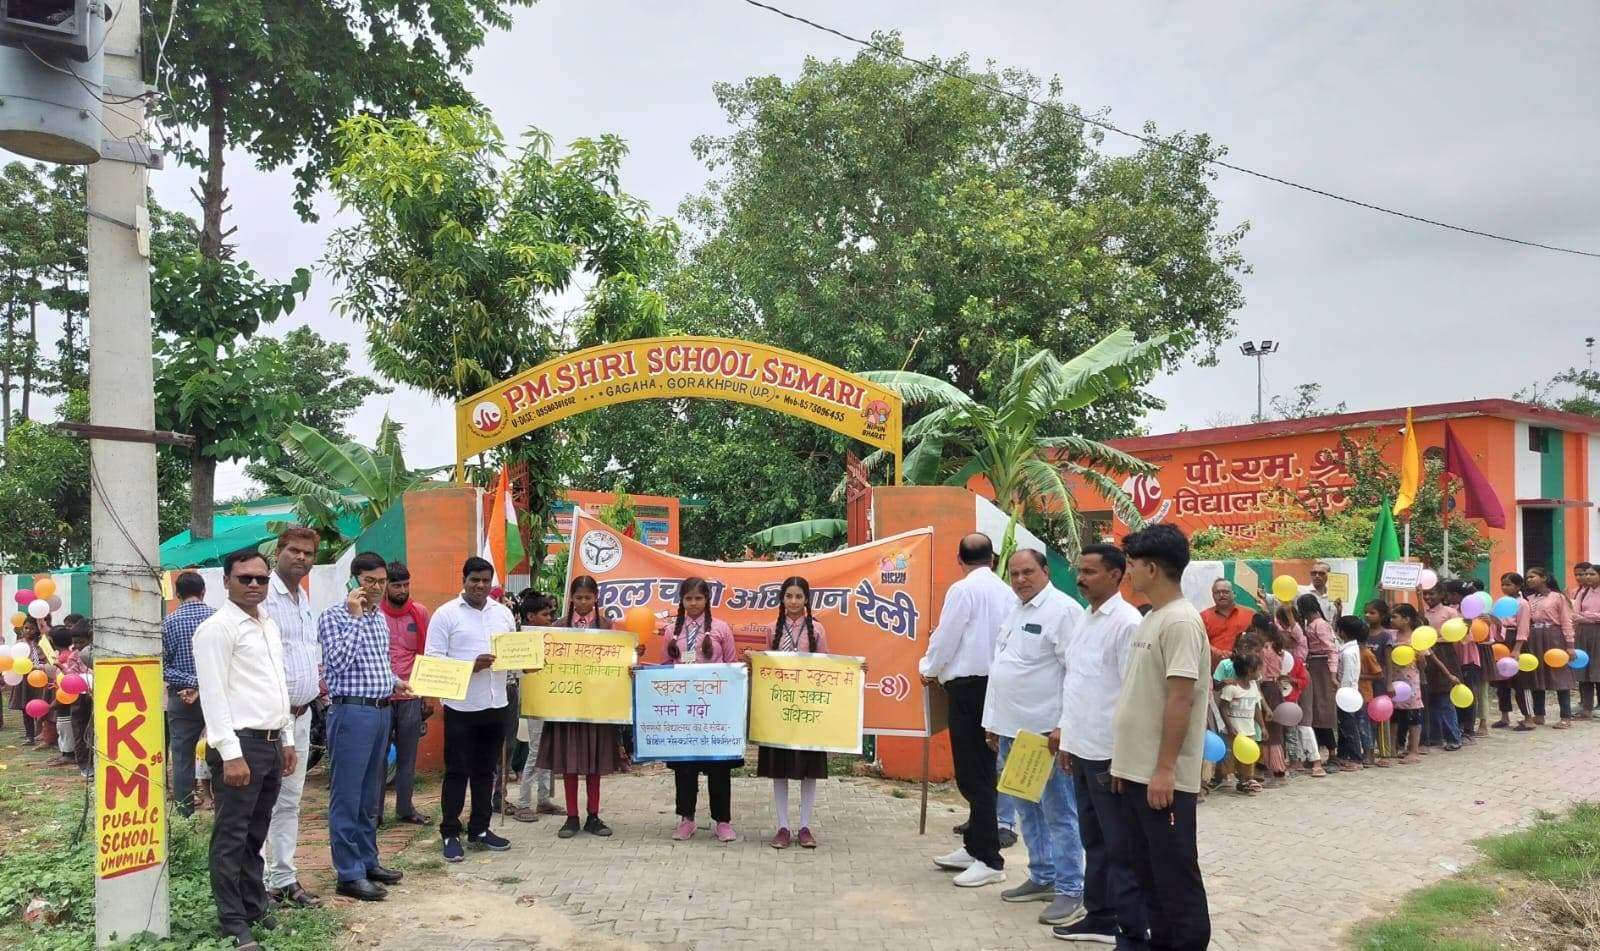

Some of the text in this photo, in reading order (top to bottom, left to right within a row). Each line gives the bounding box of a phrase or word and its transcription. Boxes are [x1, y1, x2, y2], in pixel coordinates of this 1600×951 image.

[647, 345, 758, 379] SCHOOL
[761, 357, 868, 411] SEMARI
[667, 377, 748, 394] GORAKHPUR
[749, 385, 776, 402] (U.P.)
[856, 577, 919, 641] रैली
[548, 680, 584, 695] 2026
[652, 699, 680, 717] सपने
[782, 704, 823, 723] अधिकार
[106, 665, 149, 811] AKM
[102, 806, 159, 832] PUBLIC
[100, 827, 160, 855] SCHOOL
